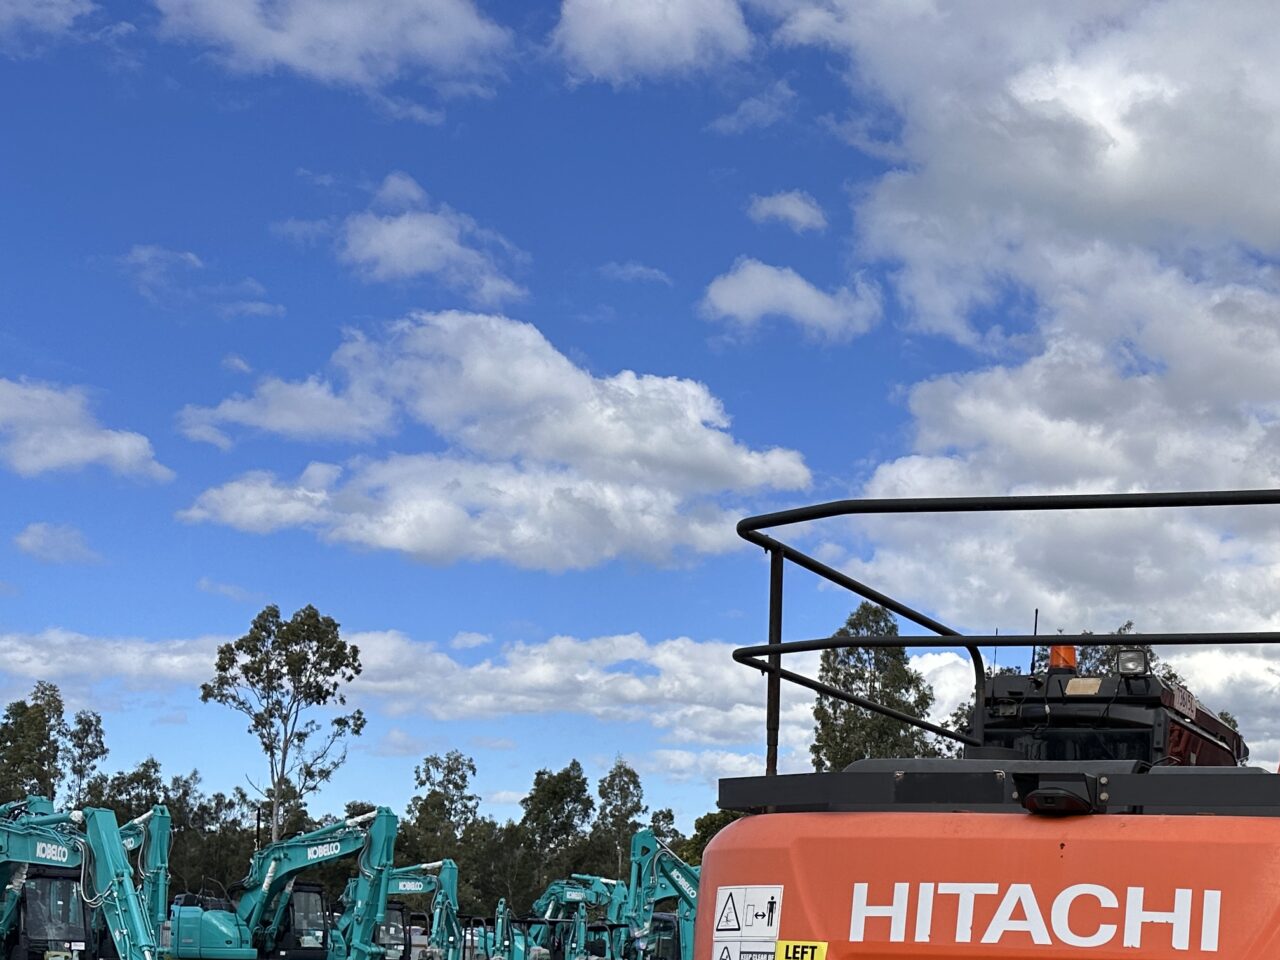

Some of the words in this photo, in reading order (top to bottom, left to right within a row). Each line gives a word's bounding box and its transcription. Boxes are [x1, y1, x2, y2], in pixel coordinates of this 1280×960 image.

[36, 842, 68, 862] KOBELCO
[307, 842, 340, 860] KOBELCO
[399, 882, 423, 891] KOBELCO
[670, 869, 697, 898] KOBELCO
[848, 882, 1222, 952] HITACHI
[785, 945, 817, 960] LEFT
